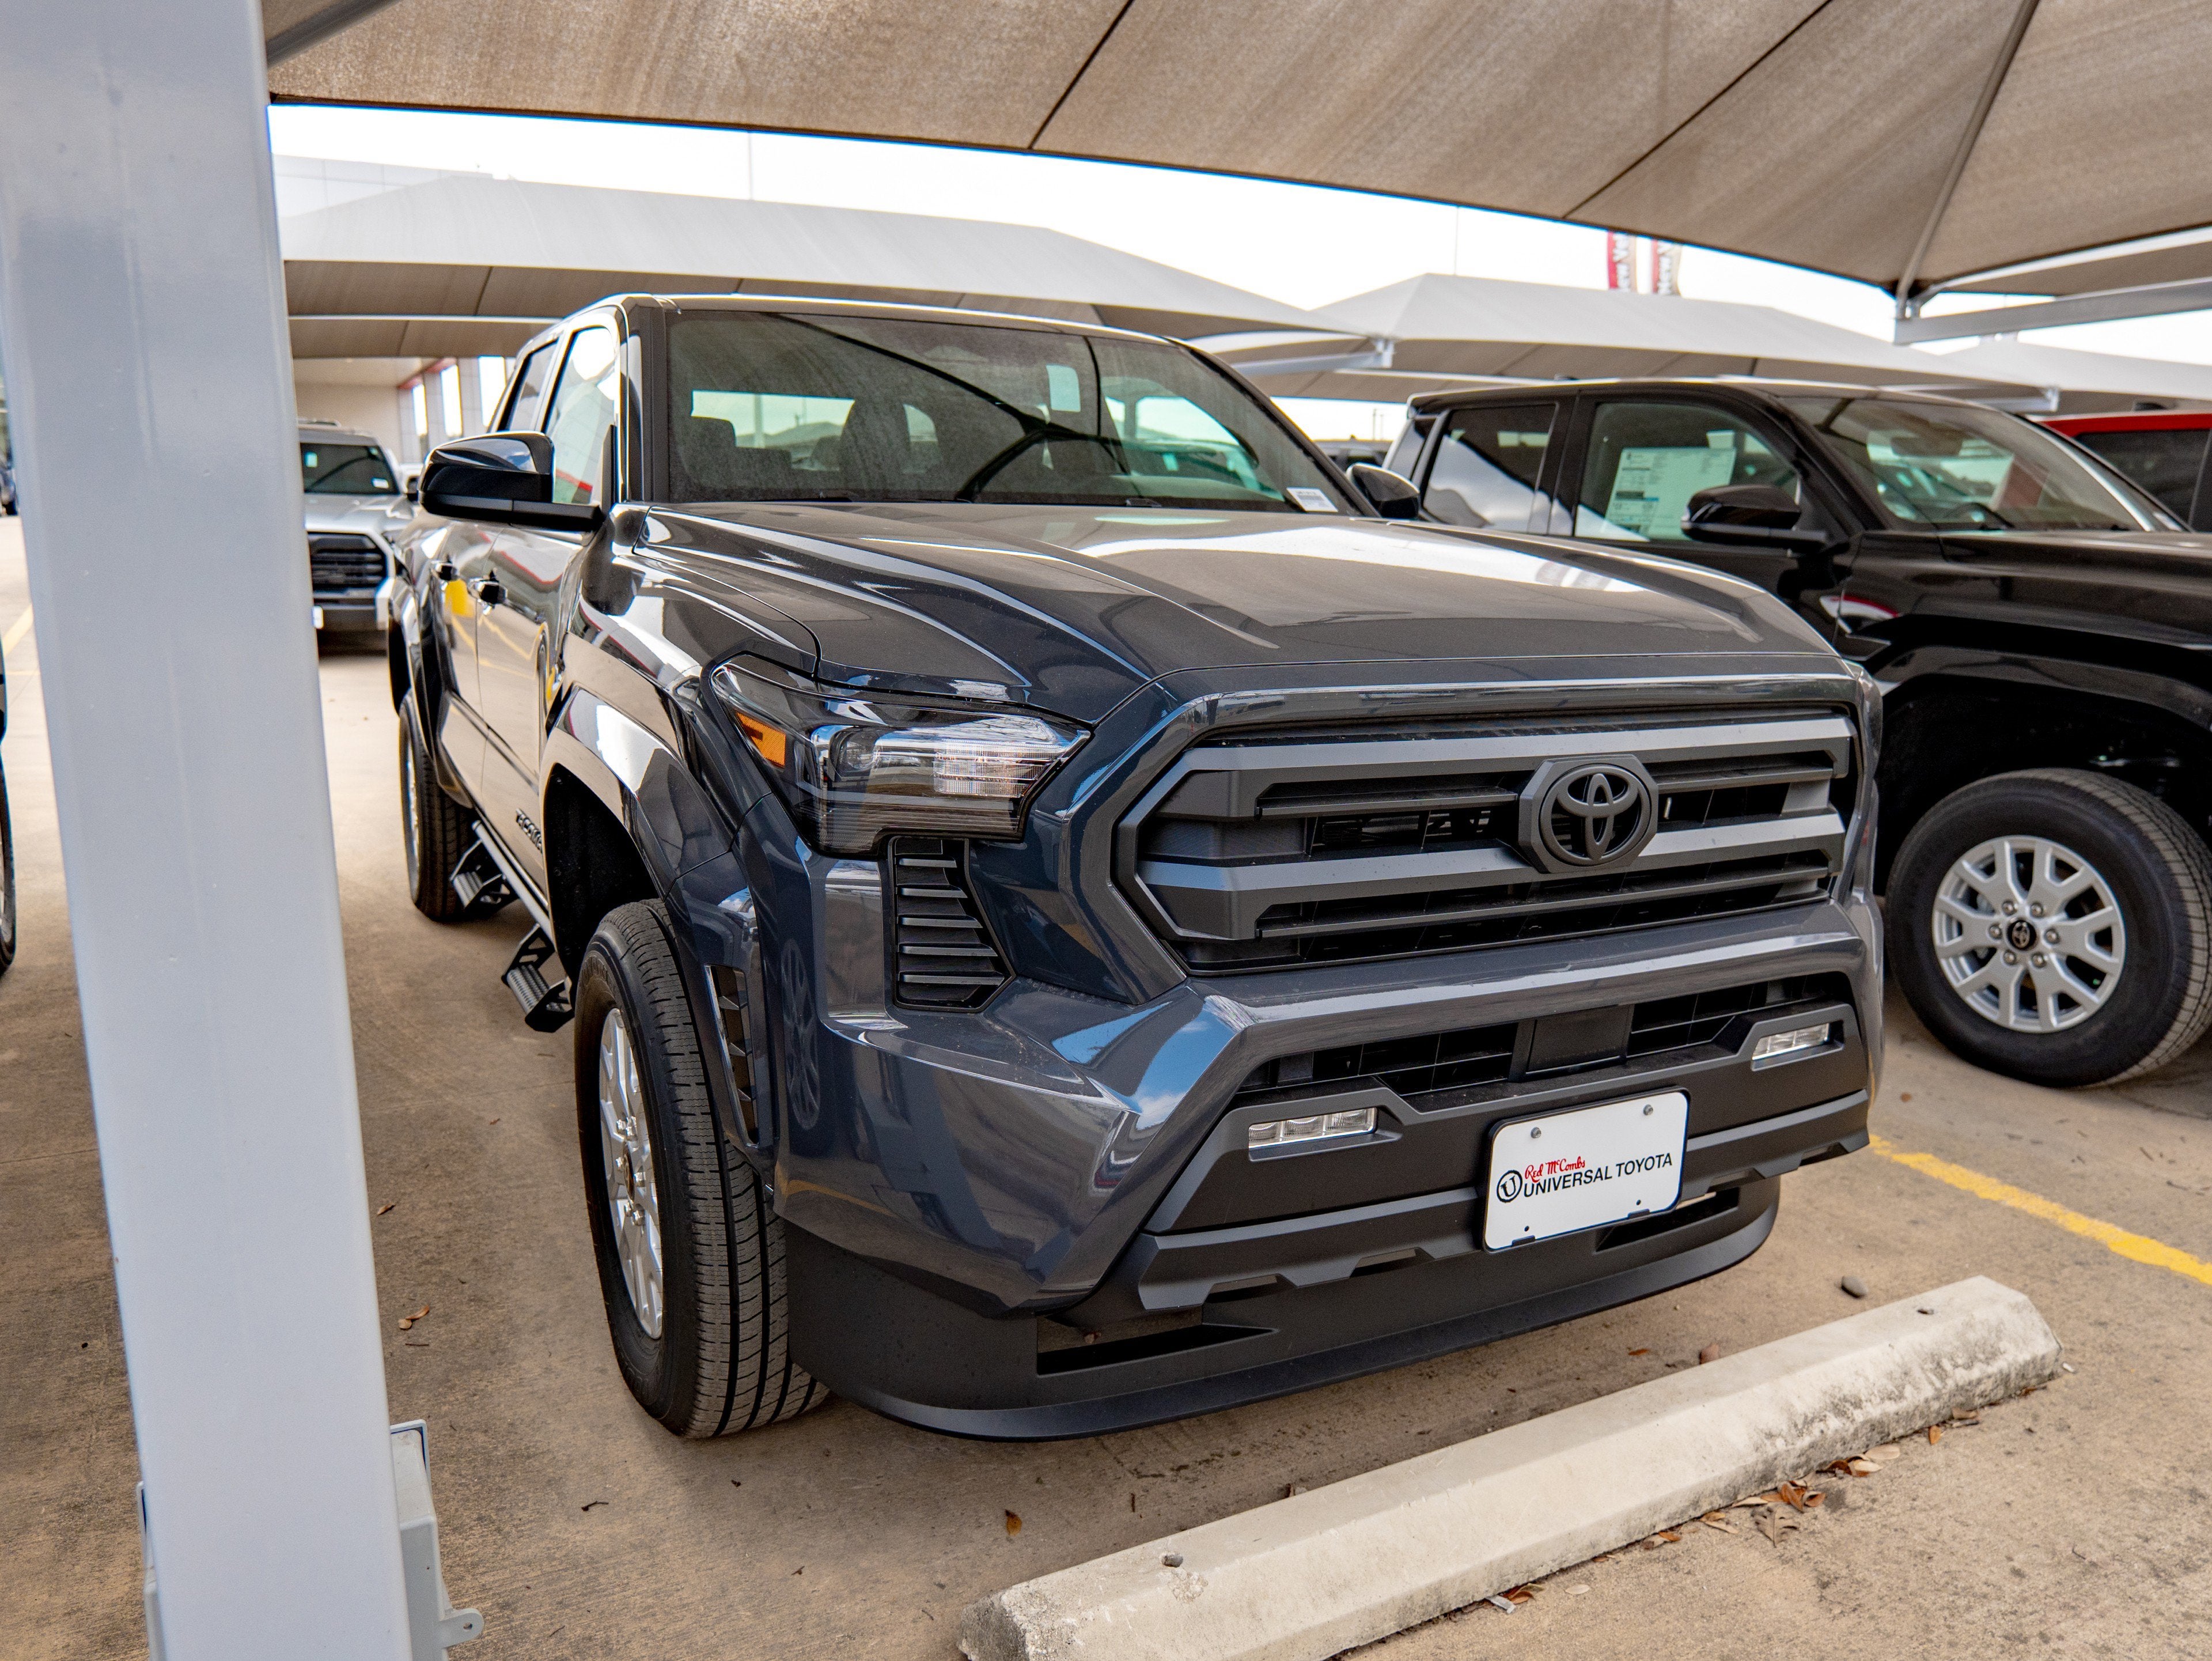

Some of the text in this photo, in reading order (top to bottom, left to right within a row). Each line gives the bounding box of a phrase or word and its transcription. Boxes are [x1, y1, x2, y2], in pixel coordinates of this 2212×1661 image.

[1524, 1156, 1586, 1183] Red McCombs
[1524, 1152, 1673, 1198] UNIVERSAL TOYOTA
